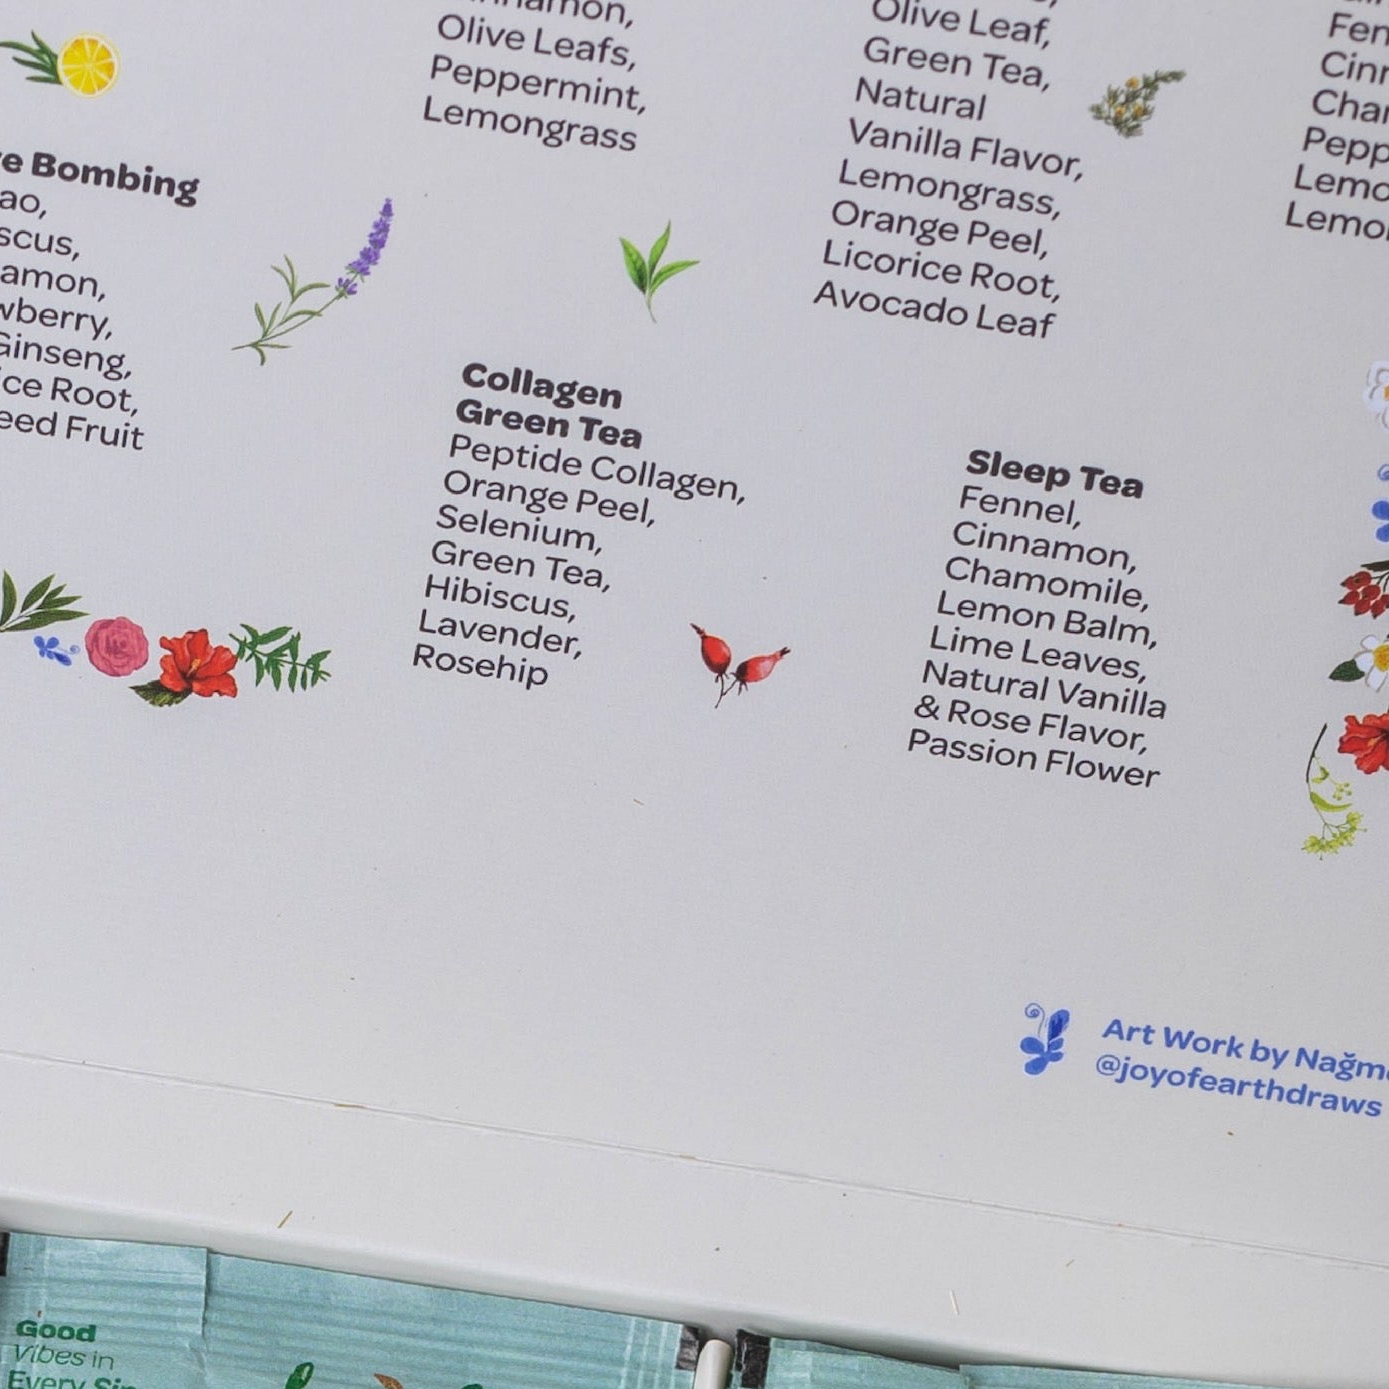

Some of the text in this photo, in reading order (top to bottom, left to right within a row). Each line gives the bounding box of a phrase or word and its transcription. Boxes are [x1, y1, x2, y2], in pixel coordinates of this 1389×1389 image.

[32, 152, 200, 207] Bombing
[823, 239, 1060, 303] Licorice Root,
[813, 280, 1057, 339] Avocado Leaf
[51, 377, 138, 417] Root,
[462, 363, 622, 409] Collagen
[66, 416, 144, 450] Fruit
[456, 399, 642, 449] Green Tea
[450, 434, 745, 506] Peptide Collagen,
[966, 450, 1143, 499] Sleep Tea
[444, 470, 654, 528] Orange Peel,
[960, 485, 1080, 530] Fennel,
[436, 504, 602, 556] Selenium,
[953, 521, 1136, 575] Cinnamon,
[432, 540, 610, 593] Green Tea,
[945, 556, 1148, 613] Chamomile,
[425, 574, 575, 623] Hibiscus,
[937, 590, 1157, 650] Lemon Balm,
[419, 609, 581, 660] Lavender,
[930, 625, 1146, 684] Lime Leaves,
[413, 643, 548, 690] Rosehip
[922, 660, 1167, 719] Natural Vanilla
[914, 695, 1147, 755] & Rose Flavor,
[908, 728, 1161, 788] Passion Flower
[1102, 1019, 1389, 1081] Art Work by Nağm
[1096, 1055, 1382, 1117] @joyofearthdraws
